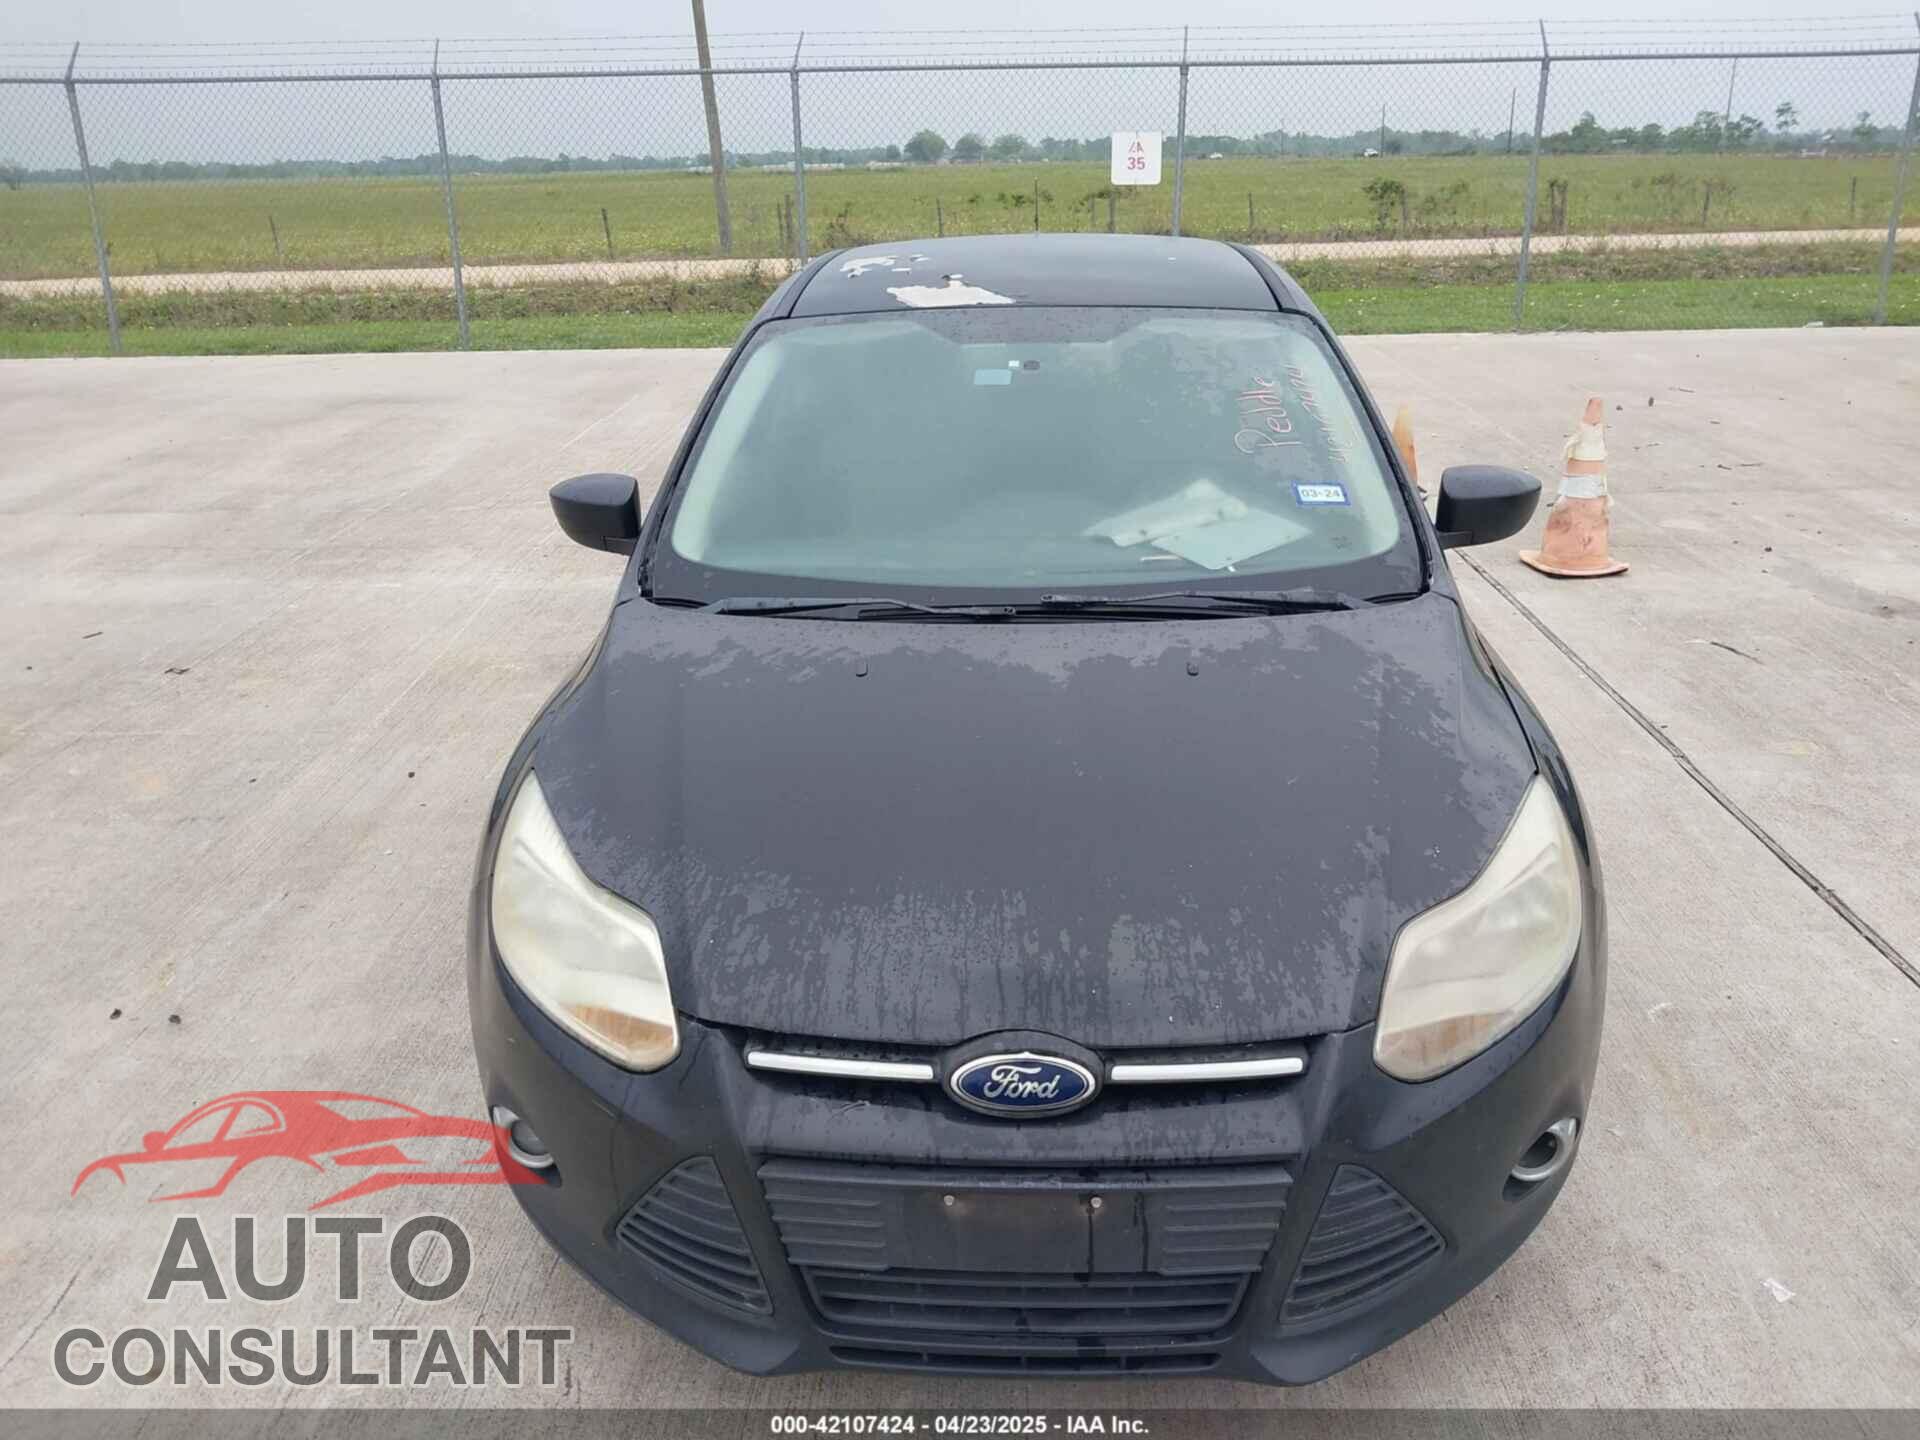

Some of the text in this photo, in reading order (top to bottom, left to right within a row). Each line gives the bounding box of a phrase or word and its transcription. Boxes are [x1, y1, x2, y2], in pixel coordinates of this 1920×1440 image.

[1127, 156, 1146, 170] 35
[1234, 375, 1303, 453] Peddle
[1300, 488, 1340, 499] 03-24
[983, 1064, 1061, 1098] Ford
